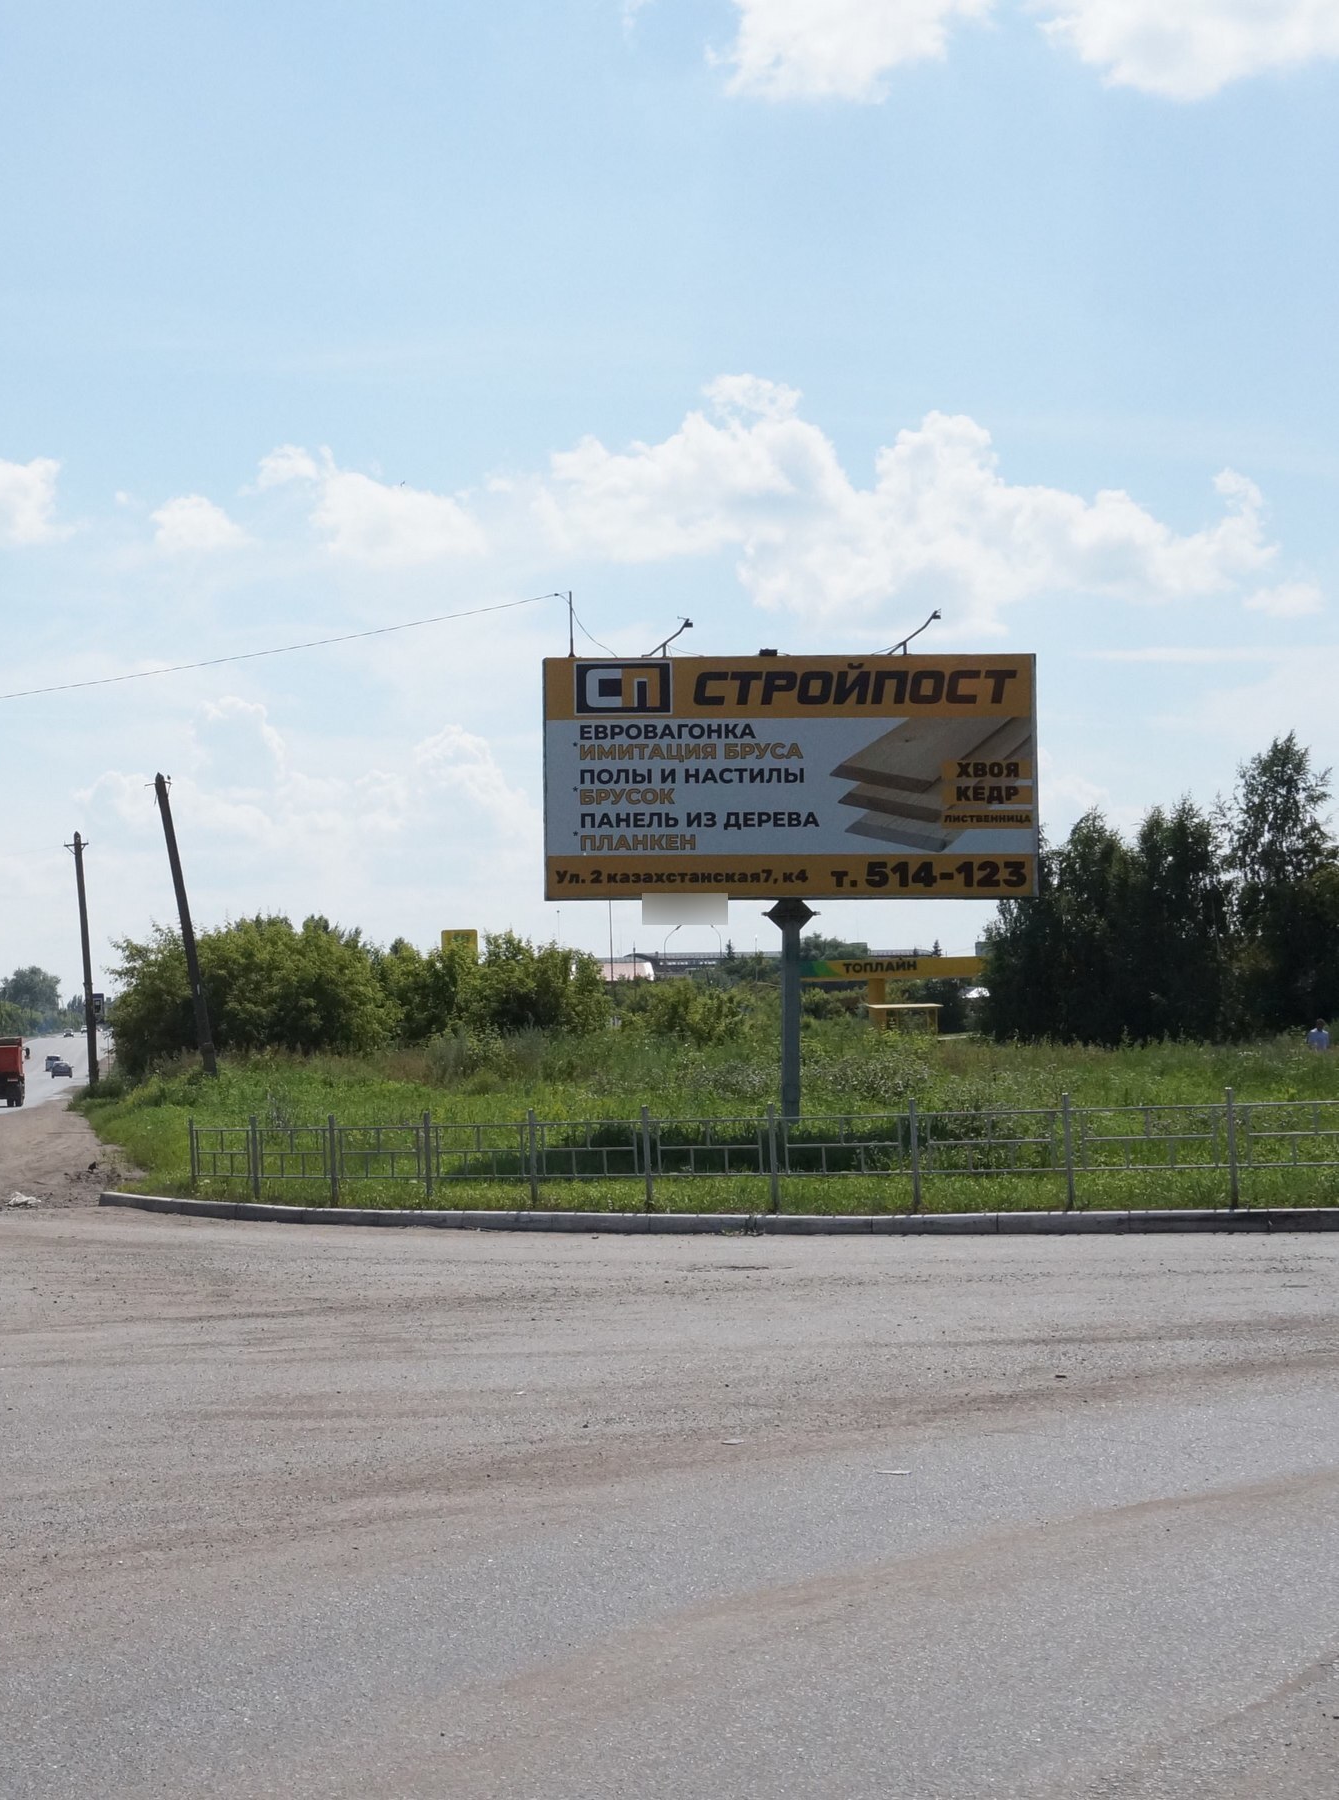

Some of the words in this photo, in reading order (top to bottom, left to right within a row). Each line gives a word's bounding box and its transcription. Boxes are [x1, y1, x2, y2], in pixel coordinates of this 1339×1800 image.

[693, 662, 1018, 706] СТРОЙПОСТ
[579, 723, 757, 741] ЕВРОВАГОНКА
[579, 743, 717, 762] ИМИТАЦИЯ
[724, 743, 804, 760] БРУСА
[579, 768, 652, 785] ПОЛЫ
[661, 768, 677, 784] И
[684, 767, 805, 784] НАСТИЛЫ
[956, 762, 1020, 778] ХВОЯ
[579, 788, 676, 806] БРУСОК
[956, 785, 1020, 805] КЕДР
[580, 812, 679, 829] ПАНЕЛЬ
[686, 811, 717, 828] ИЗ
[723, 811, 820, 830] ДЕРЕВА
[943, 814, 1032, 824] ЛИСТВЕННИЦА
[580, 834, 697, 851] ПЛАНКЕН
[555, 870, 586, 884] Ул.
[590, 869, 603, 884] 2
[782, 869, 809, 884] к4
[865, 861, 1027, 888] 514-123
[842, 958, 918, 974] ТОПЛАЙН
